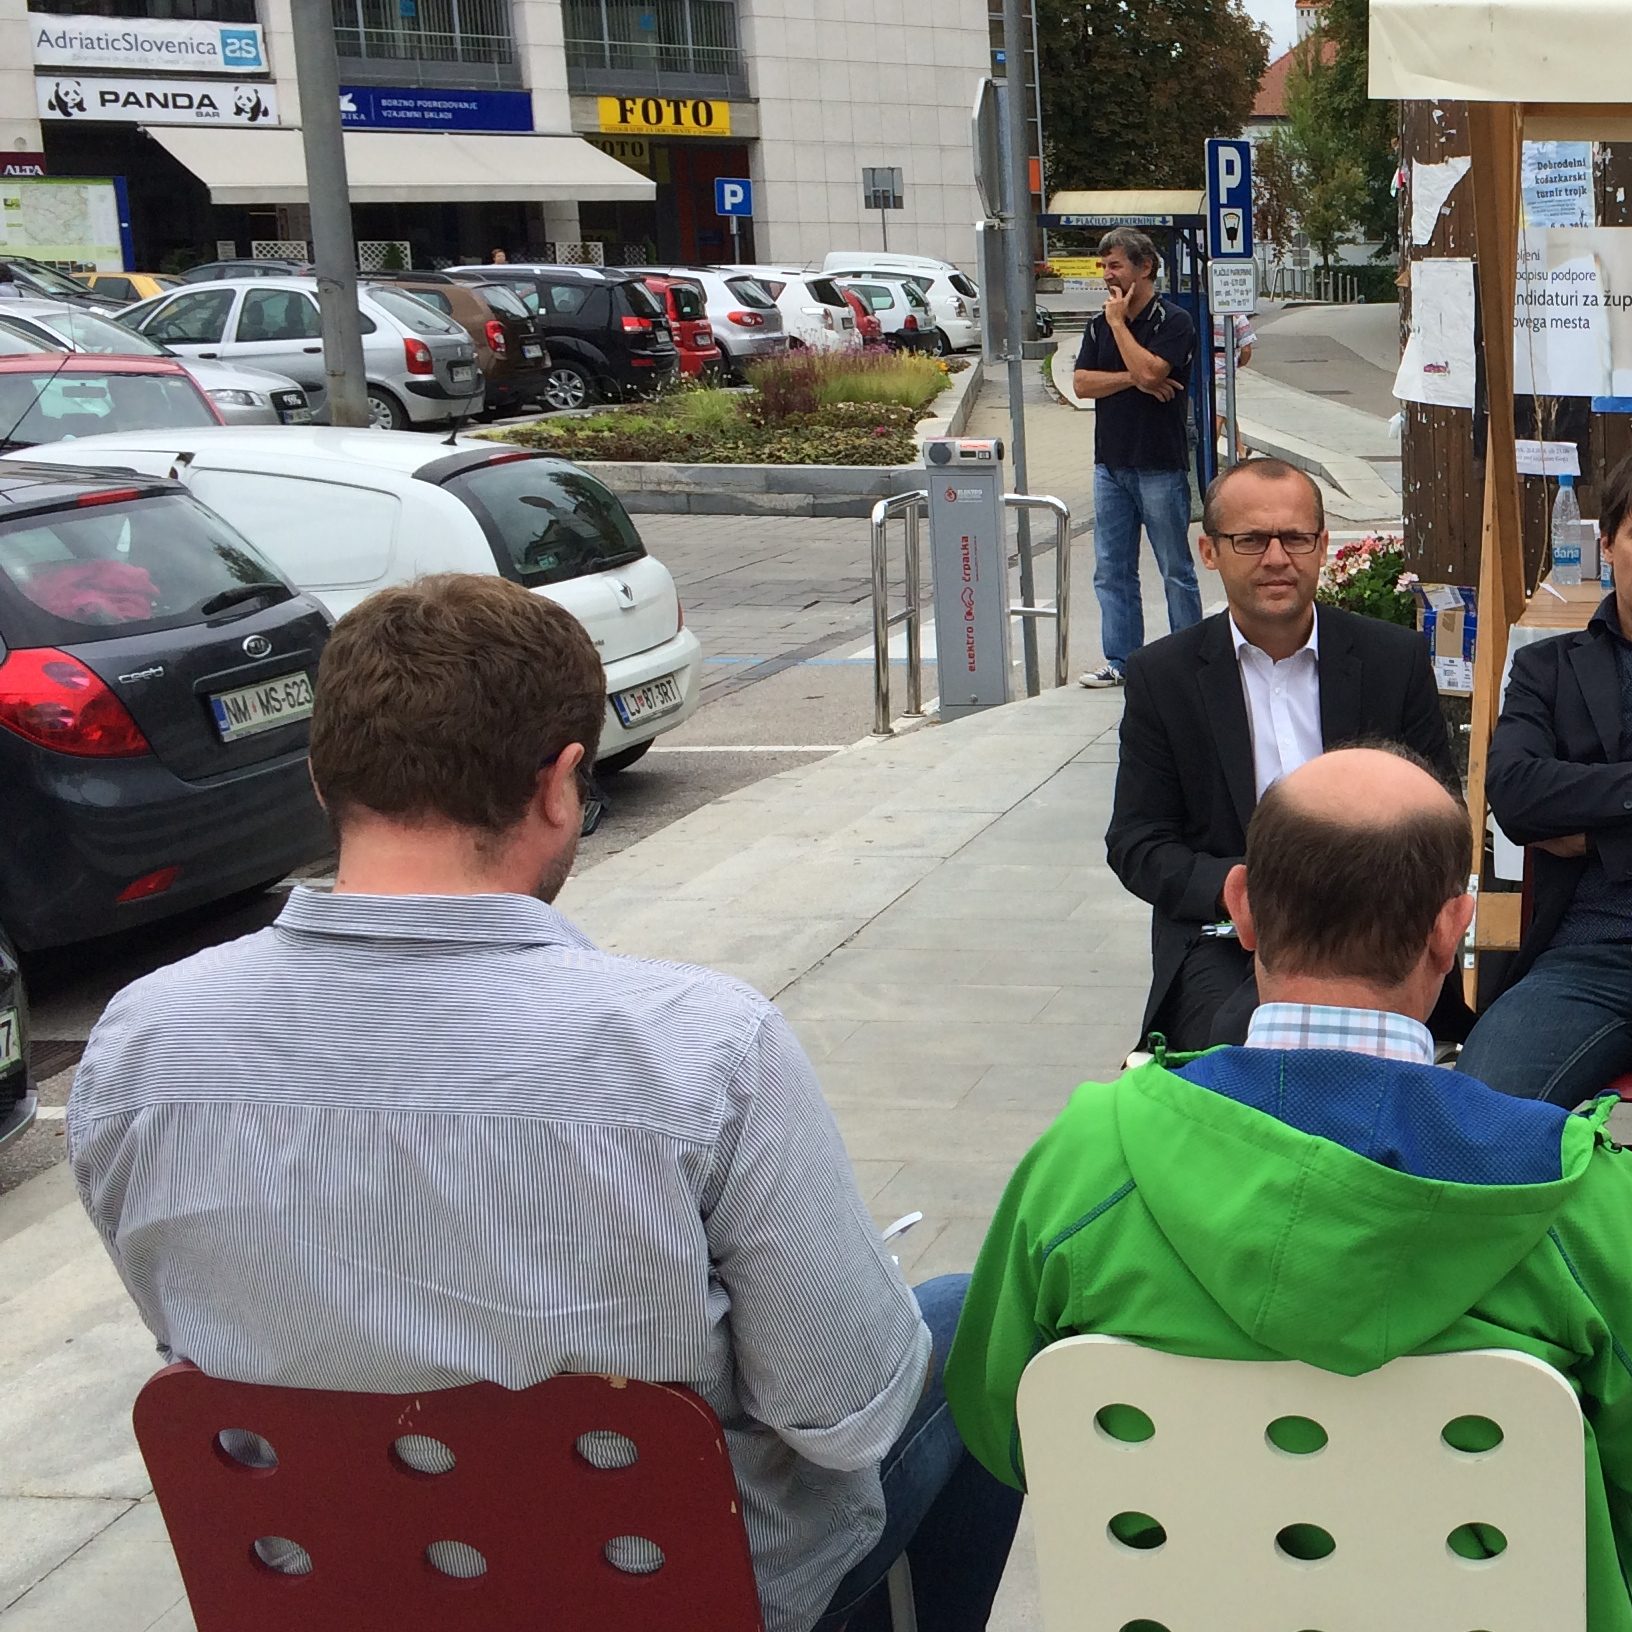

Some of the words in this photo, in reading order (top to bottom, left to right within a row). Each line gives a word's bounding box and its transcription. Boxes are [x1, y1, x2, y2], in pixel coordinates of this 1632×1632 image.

[37, 29, 218, 56] AdriaticSlovenica
[99, 90, 219, 110] PANDA
[341, 112, 366, 121] RIKA
[616, 97, 713, 128] FOTO
[4, 164, 45, 175] ALTA
[1537, 158, 1586, 171] Dobrodelni
[1218, 146, 1242, 205] P
[1535, 171, 1586, 185] košarkarski
[724, 184, 744, 210] P
[1536, 187, 1563, 199] turnir
[1564, 185, 1587, 198] trojk
[1516, 269, 1549, 284] odpisu
[1551, 268, 1597, 285] podpore
[1515, 289, 1578, 307] ndidaturi
[1583, 296, 1599, 307] za
[1513, 317, 1547, 332] ovega
[1550, 316, 1591, 330] mesta
[960, 535, 972, 583] črpalka
[1554, 547, 1580, 558] dana
[965, 626, 977, 673] elektro
[224, 696, 253, 726] NM
[256, 678, 314, 717] MS-623
